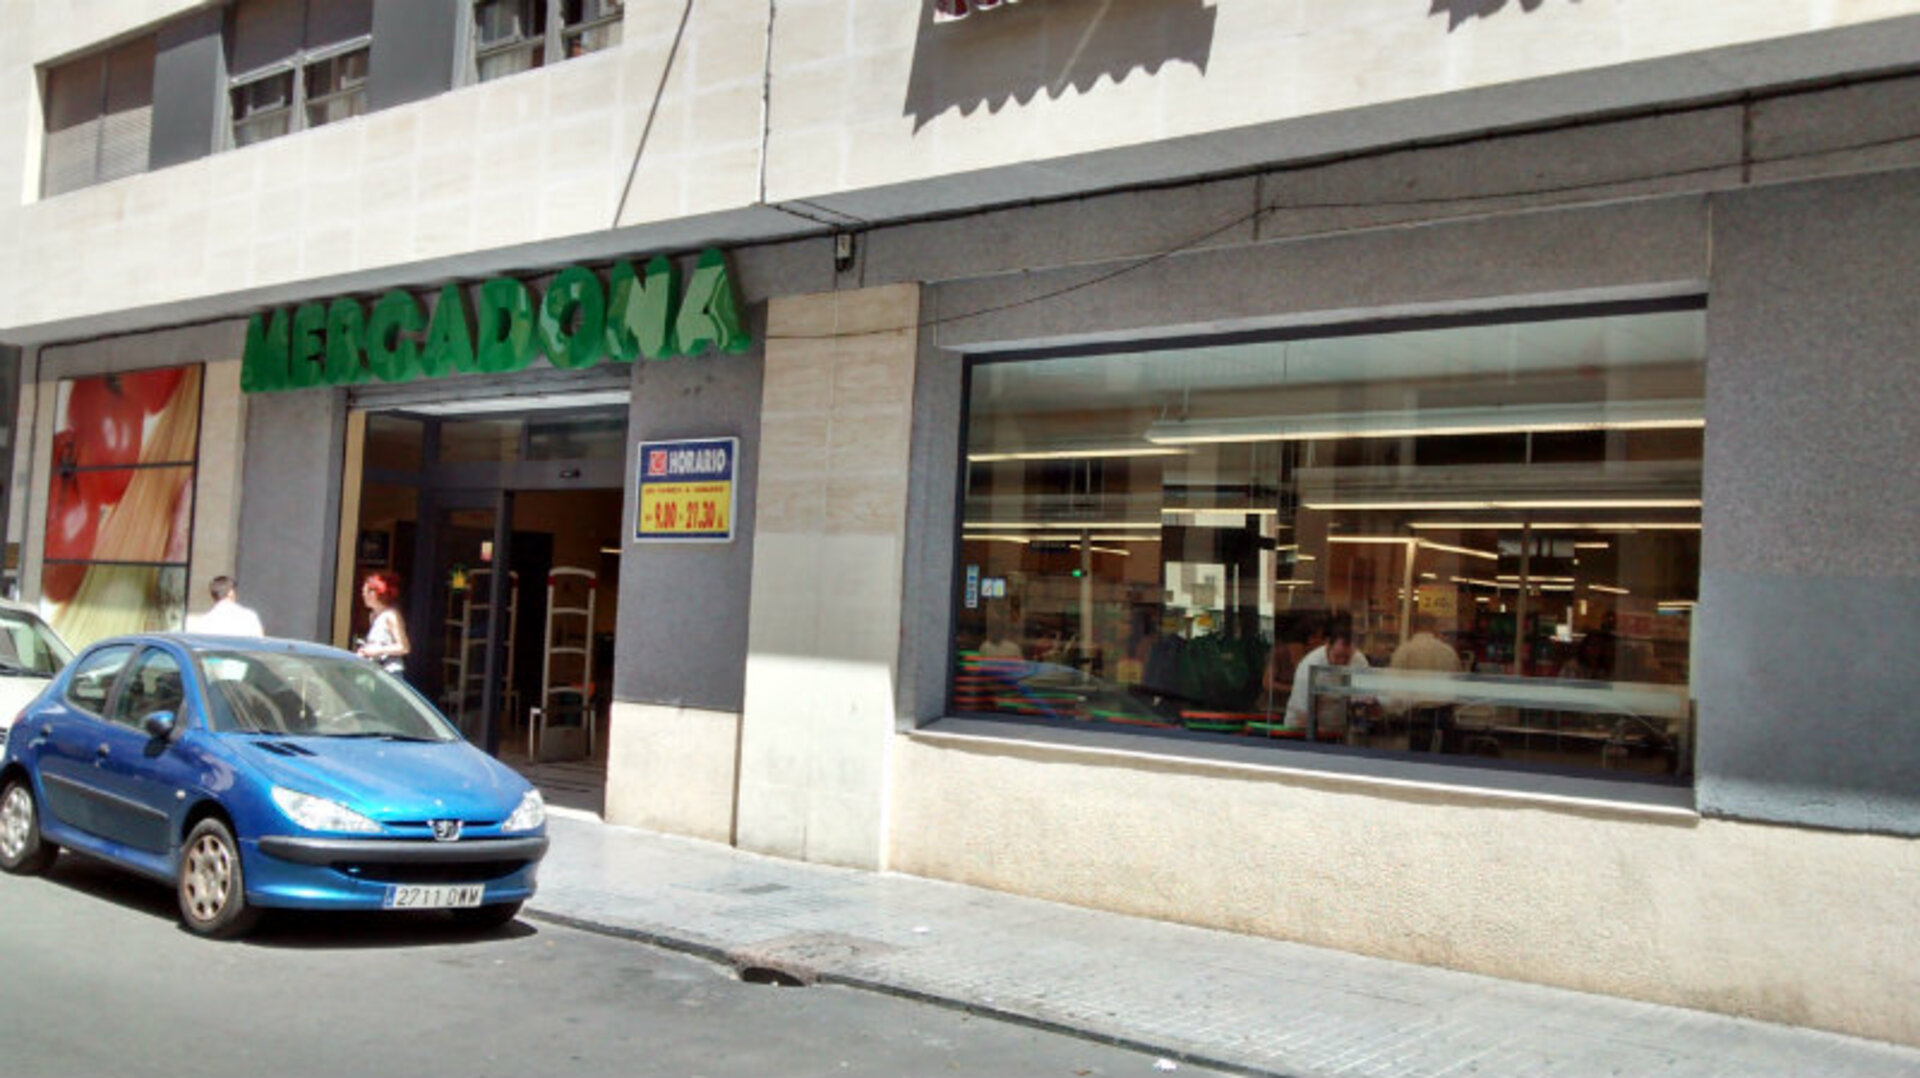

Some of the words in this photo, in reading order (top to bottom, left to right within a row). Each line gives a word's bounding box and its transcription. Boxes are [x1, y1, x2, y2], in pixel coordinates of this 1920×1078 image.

[240, 248, 751, 393] MERCADONA
[669, 448, 726, 474] HORARIO
[397, 887, 441, 906] 2711
